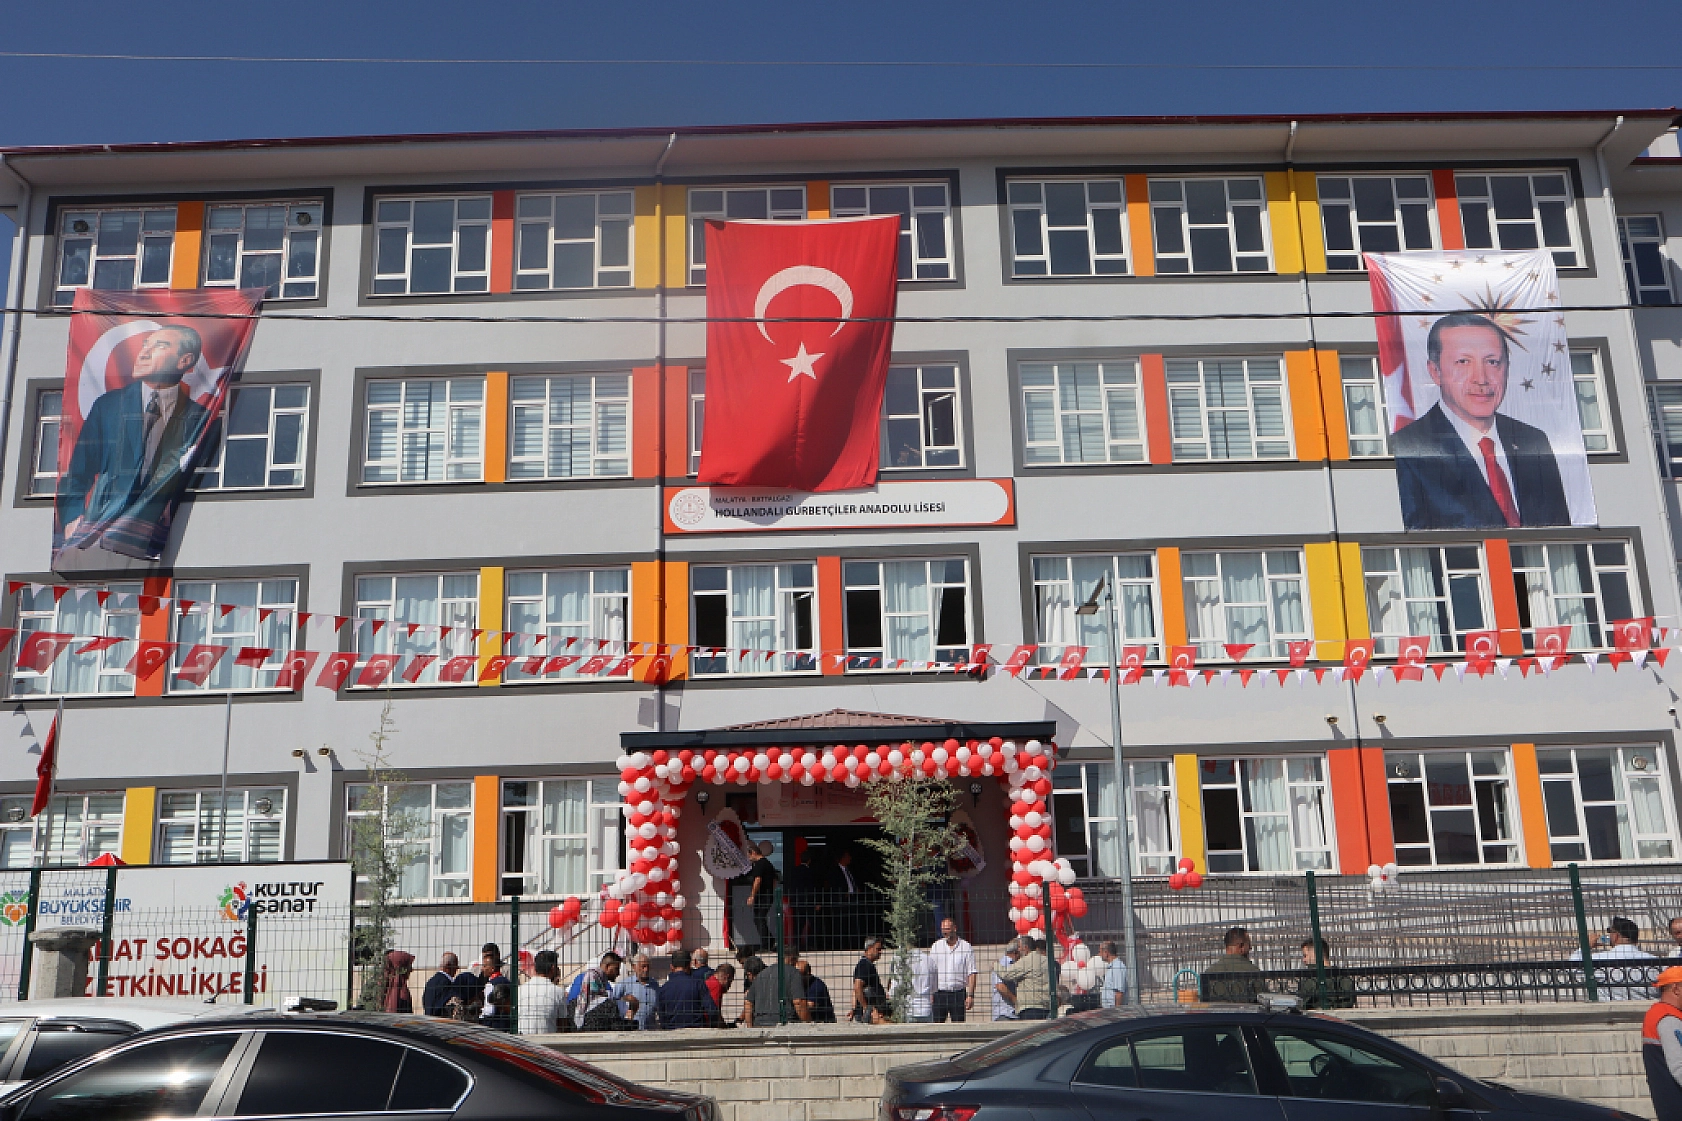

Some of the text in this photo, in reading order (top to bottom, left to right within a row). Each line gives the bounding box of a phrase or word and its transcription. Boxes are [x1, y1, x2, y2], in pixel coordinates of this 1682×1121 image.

[715, 506, 784, 519] HOLLANDALI
[785, 503, 857, 517] GURBETÇİLER
[859, 503, 911, 514] ANADOLU
[914, 500, 946, 513] LİSESİ
[63, 886, 107, 898] MALATY
[155, 930, 248, 961] SOKAĞ
